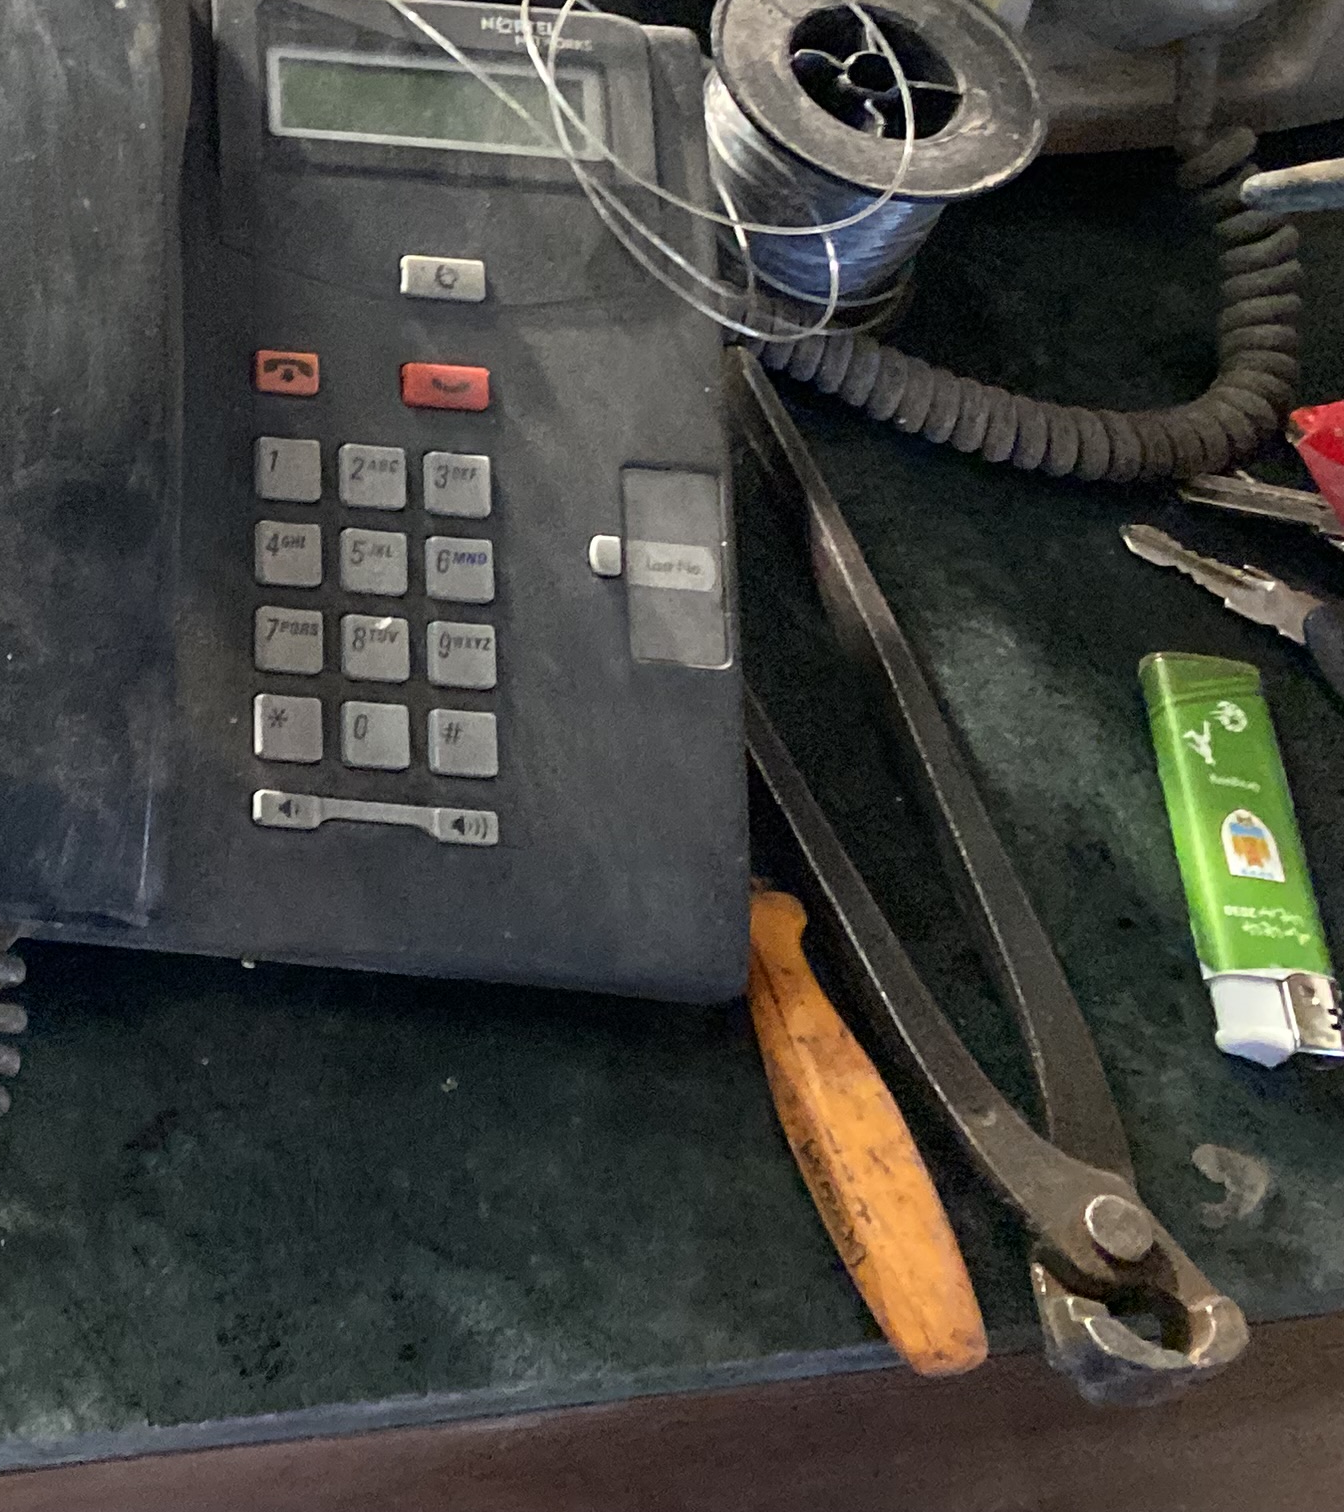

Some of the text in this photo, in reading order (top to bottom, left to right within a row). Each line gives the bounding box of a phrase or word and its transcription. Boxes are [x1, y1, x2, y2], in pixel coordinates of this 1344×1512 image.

[480, 15, 553, 36] NOREL
[269, 450, 279, 472] 1
[354, 714, 368, 740] 0
